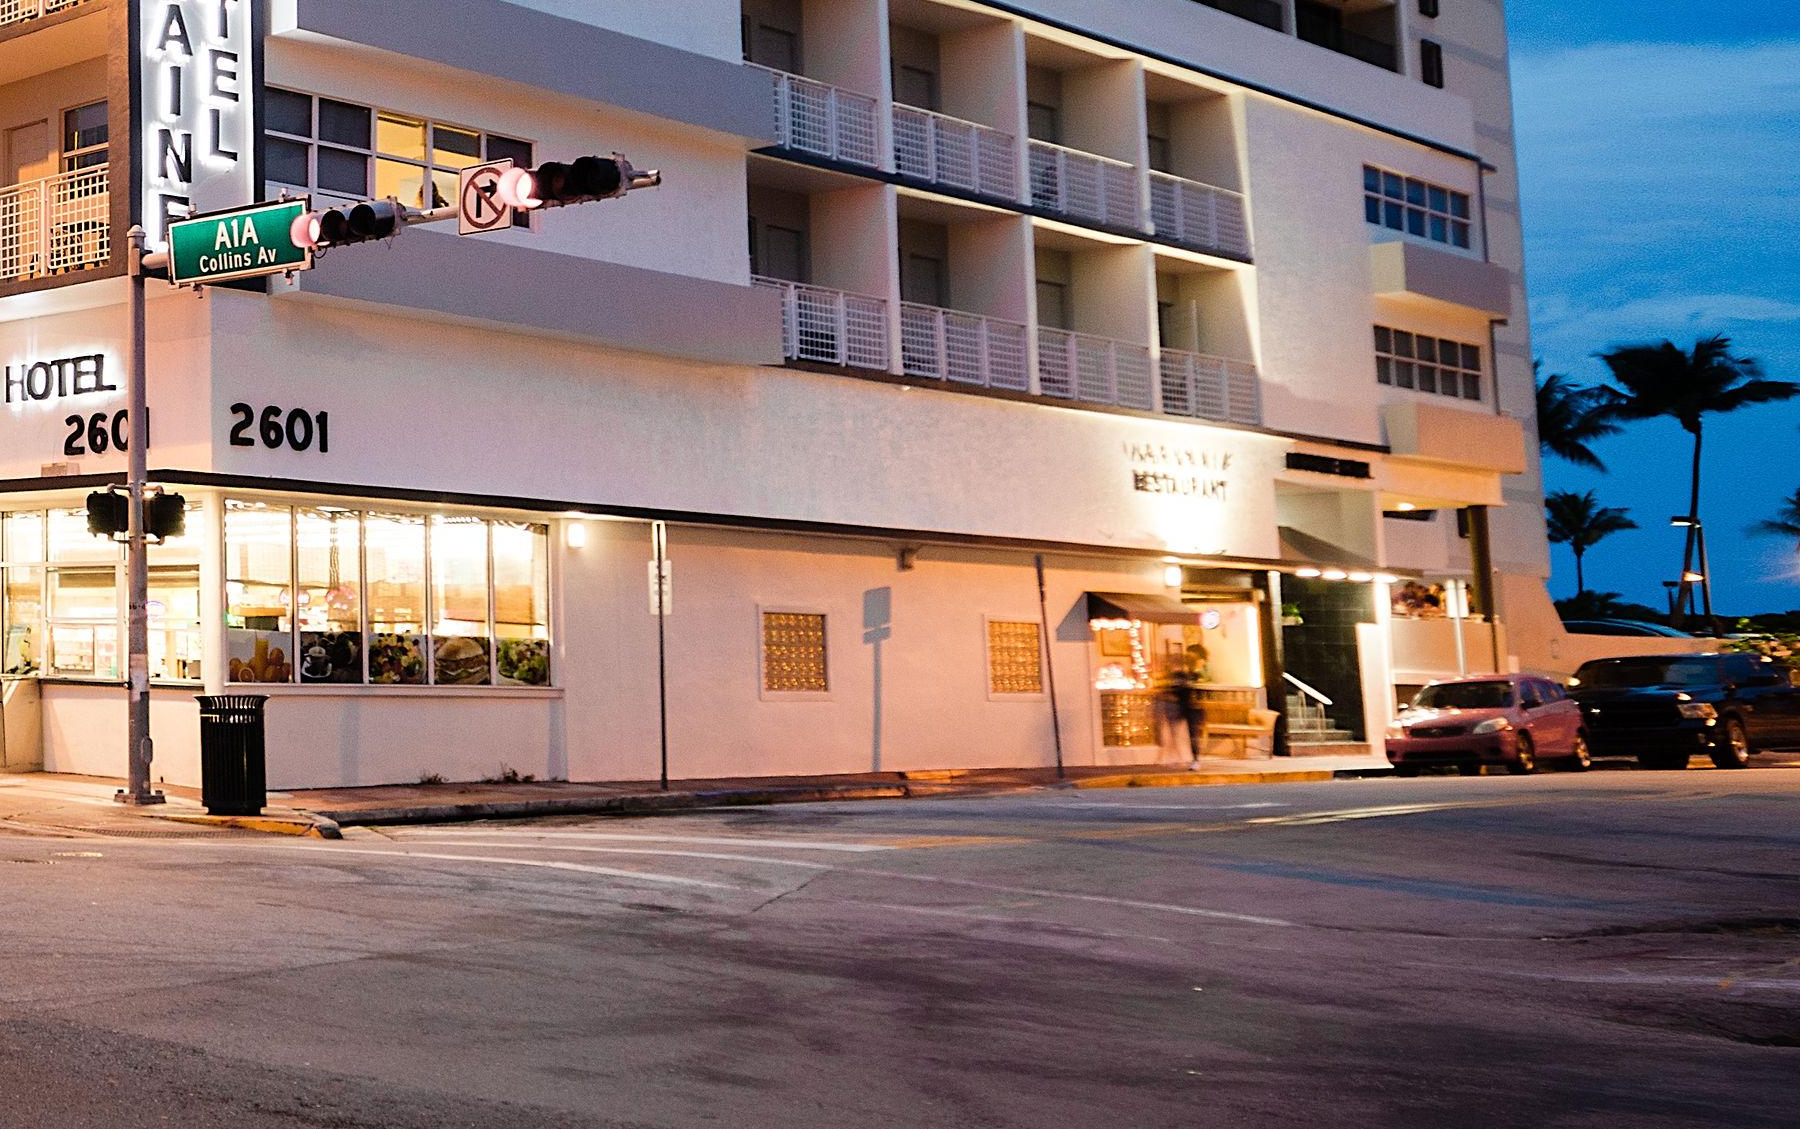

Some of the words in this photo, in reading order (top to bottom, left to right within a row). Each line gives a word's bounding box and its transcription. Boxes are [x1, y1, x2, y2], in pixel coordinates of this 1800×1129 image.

[214, 216, 259, 251] A1A
[199, 251, 252, 273] Collins
[257, 246, 277, 265] Av
[5, 354, 117, 404] HOTEL
[229, 402, 329, 453] 2601
